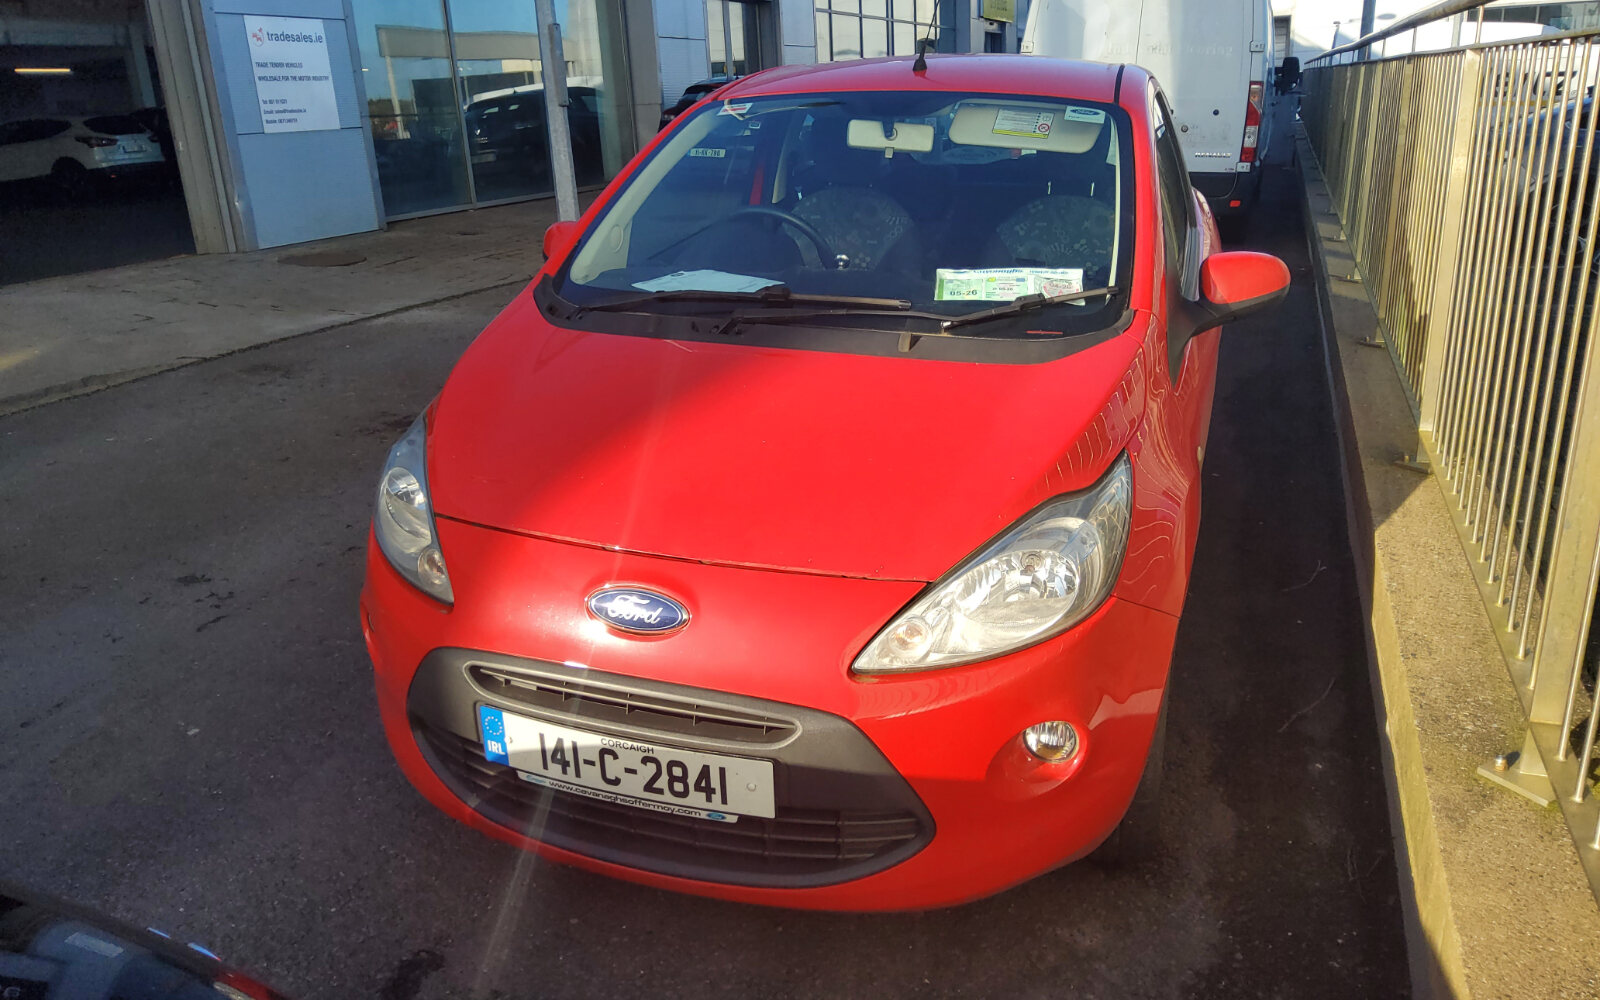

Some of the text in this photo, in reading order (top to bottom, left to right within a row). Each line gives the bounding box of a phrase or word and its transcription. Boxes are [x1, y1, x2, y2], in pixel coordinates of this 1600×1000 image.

[266, 30, 324, 43] tradesales.ie
[603, 594, 664, 625] Ford
[487, 739, 506, 755] IRL
[600, 737, 655, 755] CORCAIGH
[539, 733, 728, 805] 141-C-2841
[548, 780, 702, 817] www.cavanaghsoffermoy.com
